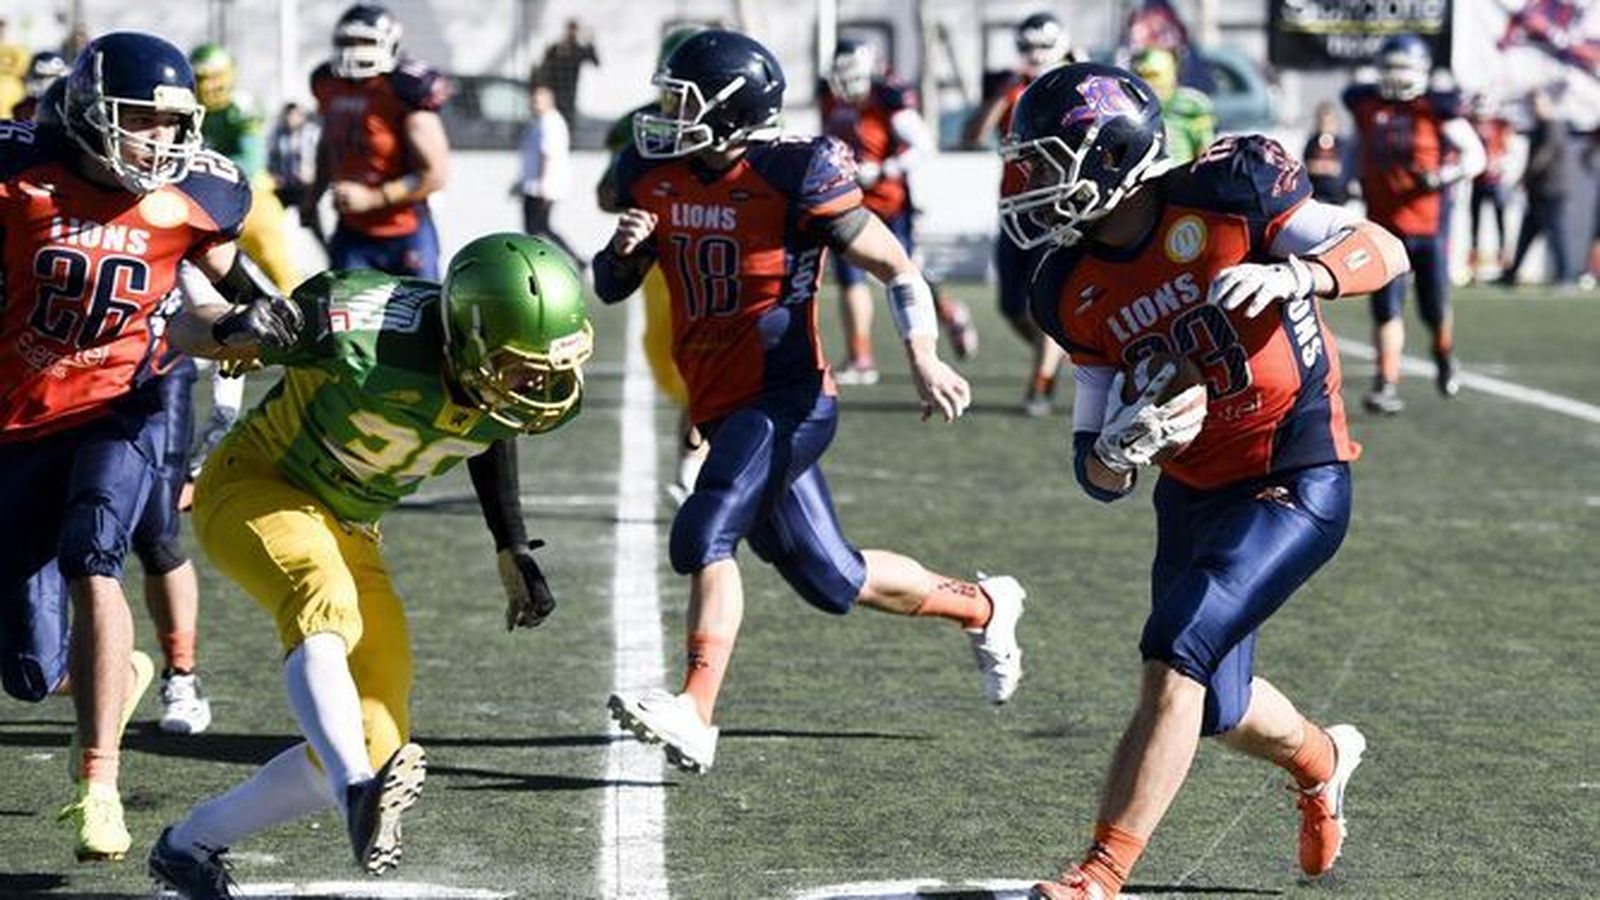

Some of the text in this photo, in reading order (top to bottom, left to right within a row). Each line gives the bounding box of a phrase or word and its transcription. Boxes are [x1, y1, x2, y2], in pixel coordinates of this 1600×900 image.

[50, 215, 151, 255] LIONS
[671, 203, 738, 231] LIONS
[28, 245, 149, 352] 26
[671, 234, 743, 323] 18
[1107, 272, 1202, 343] LIONS
[1286, 299, 1322, 370] ONS
